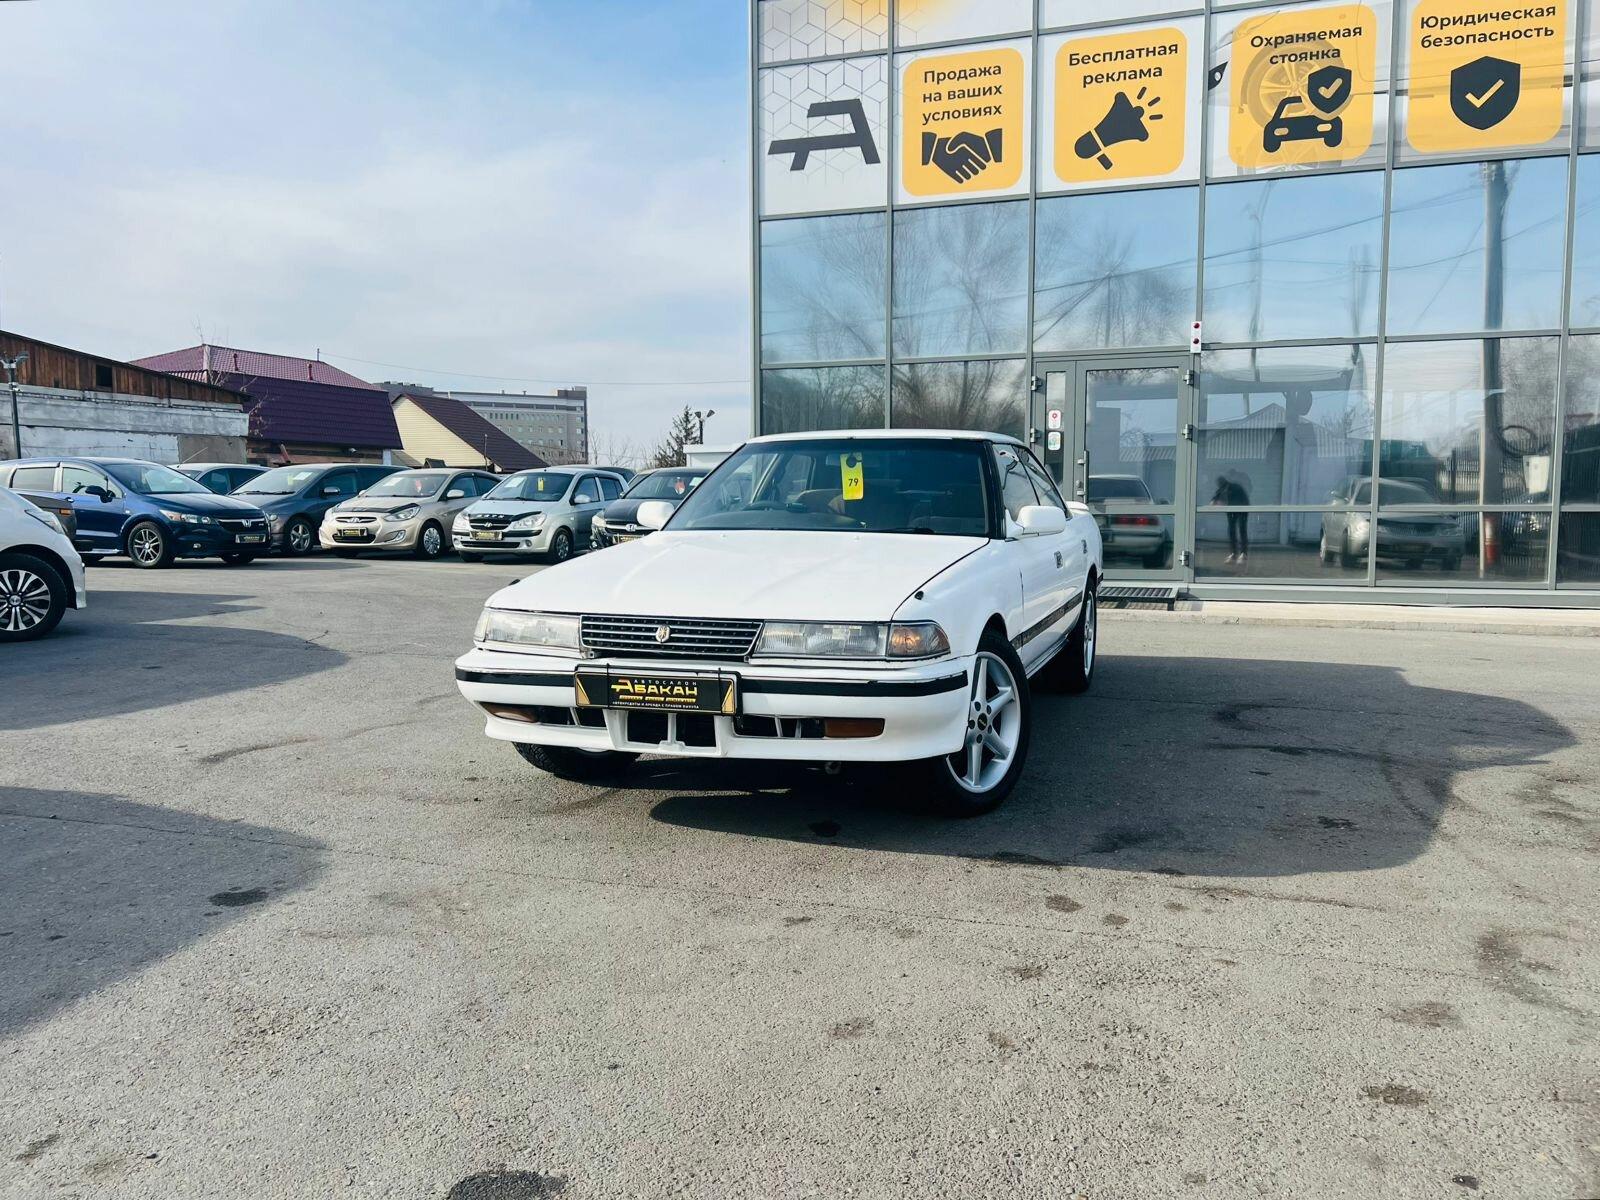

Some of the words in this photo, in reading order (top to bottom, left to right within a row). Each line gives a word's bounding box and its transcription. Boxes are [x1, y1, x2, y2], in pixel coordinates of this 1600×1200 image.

[1420, 6, 1556, 30] Юридическая
[1250, 26, 1362, 48] Охраняемая
[1420, 26, 1555, 48] безопасность
[1069, 43, 1178, 66] Бесплатная
[1269, 48, 1341, 65] стоянка
[923, 65, 1002, 85] Продажа
[1083, 66, 1163, 88] реклама
[922, 92, 942, 103] на
[947, 85, 1002, 100] ваших
[922, 105, 1002, 126] условиях
[848, 478, 859, 487] 79
